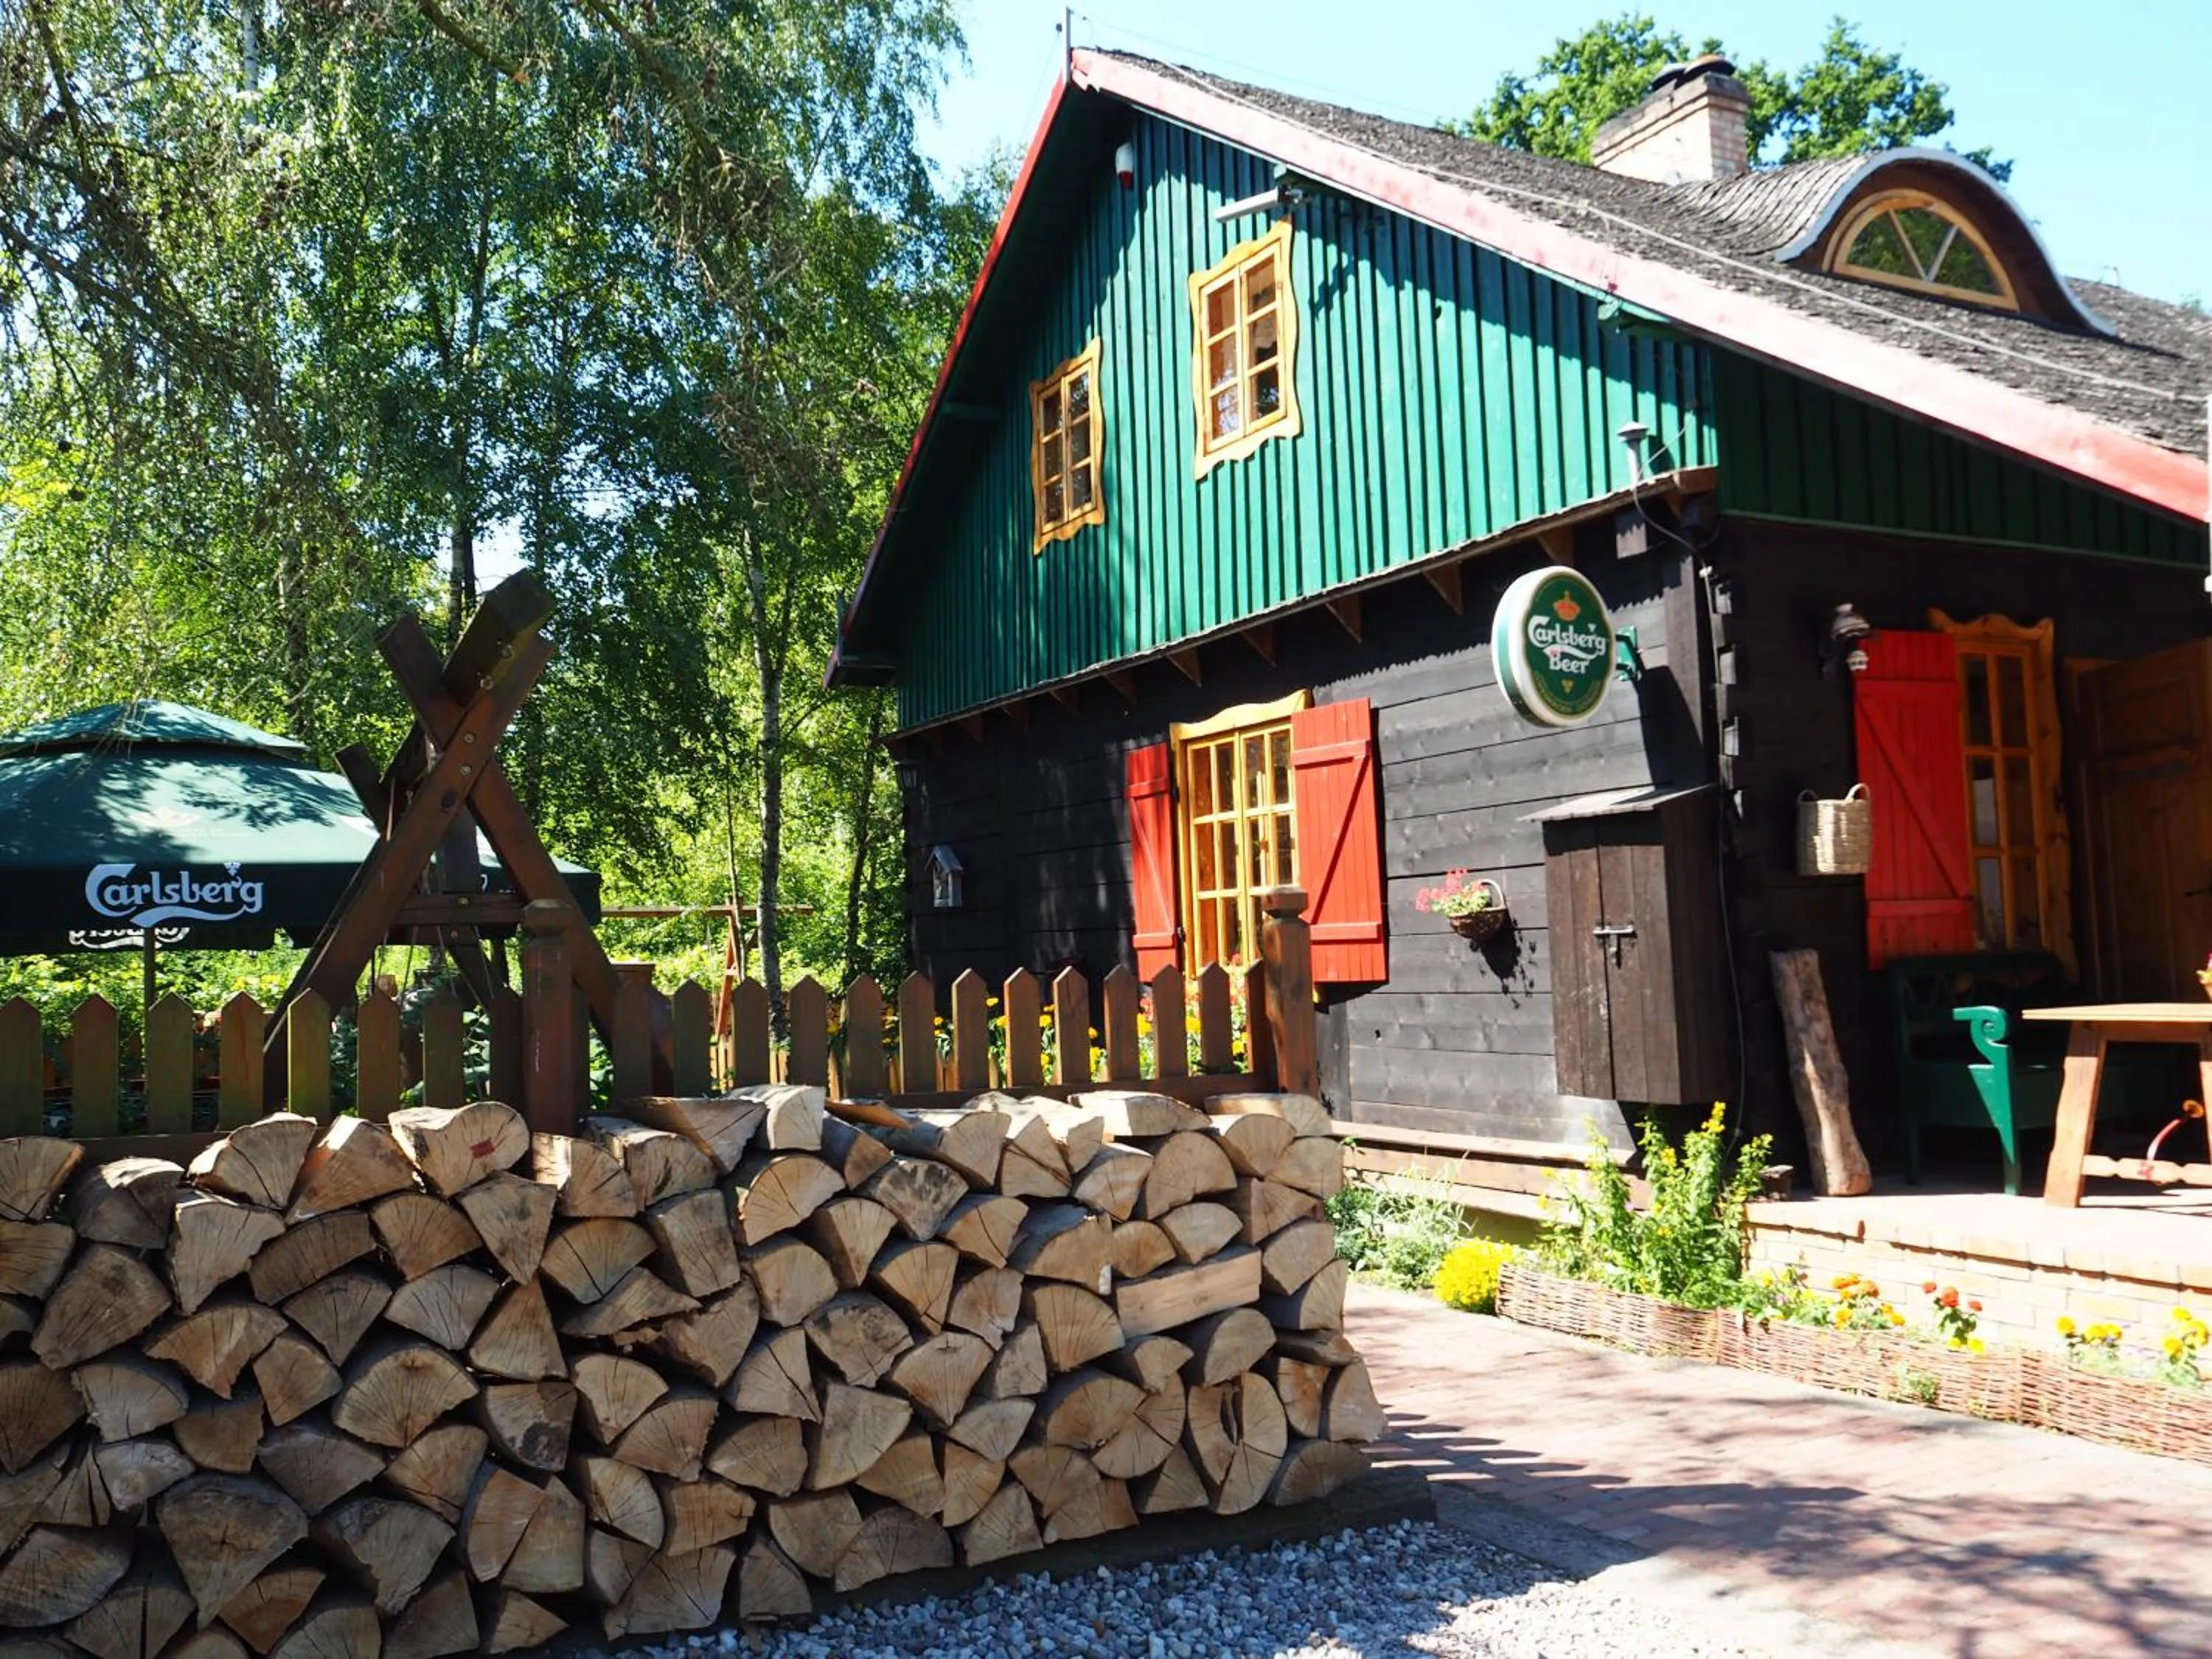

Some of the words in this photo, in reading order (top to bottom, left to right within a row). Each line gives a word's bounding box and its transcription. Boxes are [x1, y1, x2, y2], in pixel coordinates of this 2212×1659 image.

[1527, 615, 1607, 659] Carlsberg
[1549, 649, 1589, 674] Beer
[85, 863, 264, 923] Carlsberg
